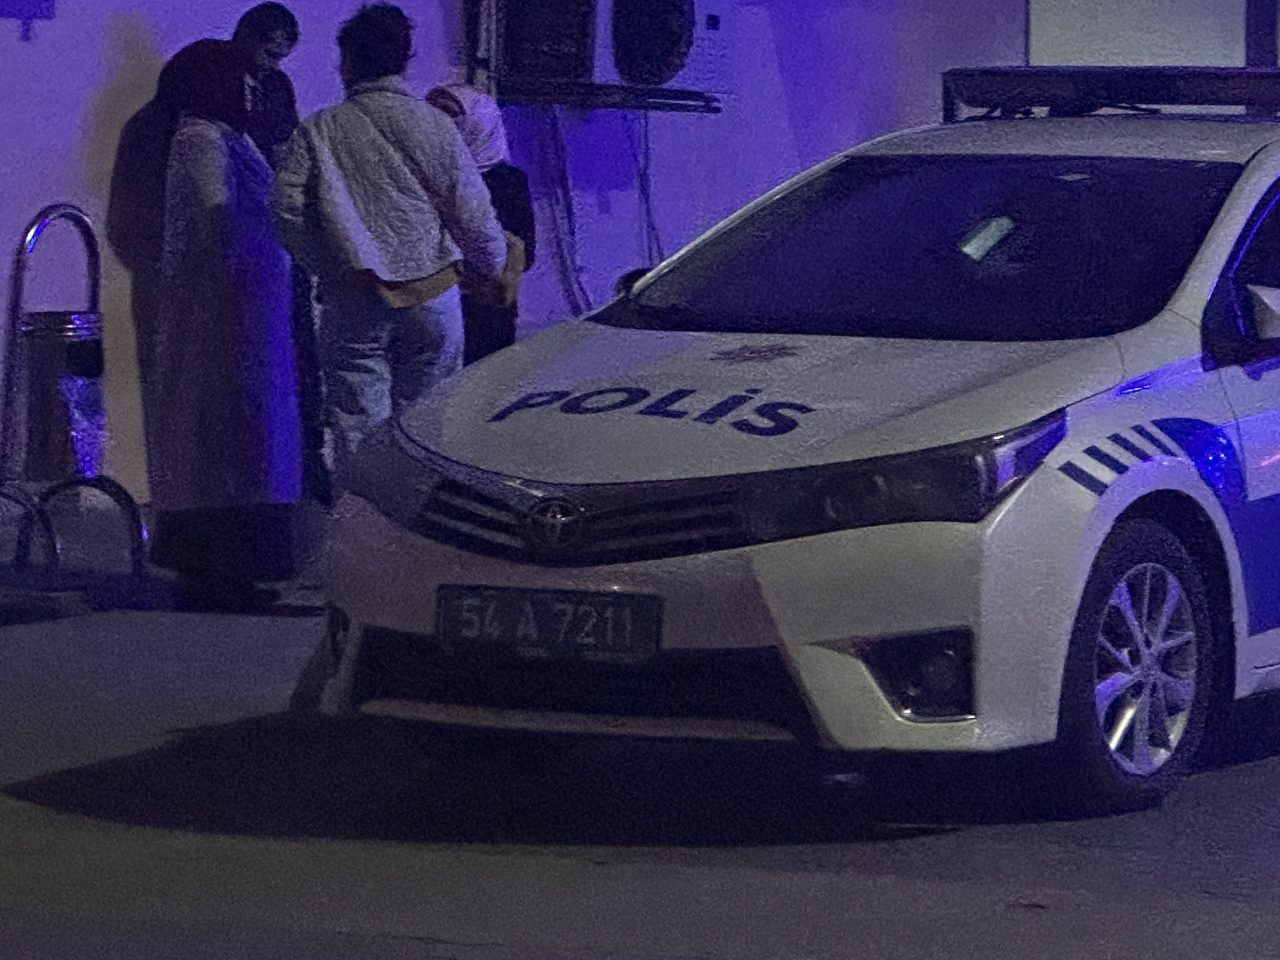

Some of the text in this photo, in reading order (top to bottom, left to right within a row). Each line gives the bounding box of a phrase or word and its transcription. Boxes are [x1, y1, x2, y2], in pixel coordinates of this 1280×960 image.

[487, 386, 815, 436] POLİS
[459, 596, 634, 648] 54 A 7211
